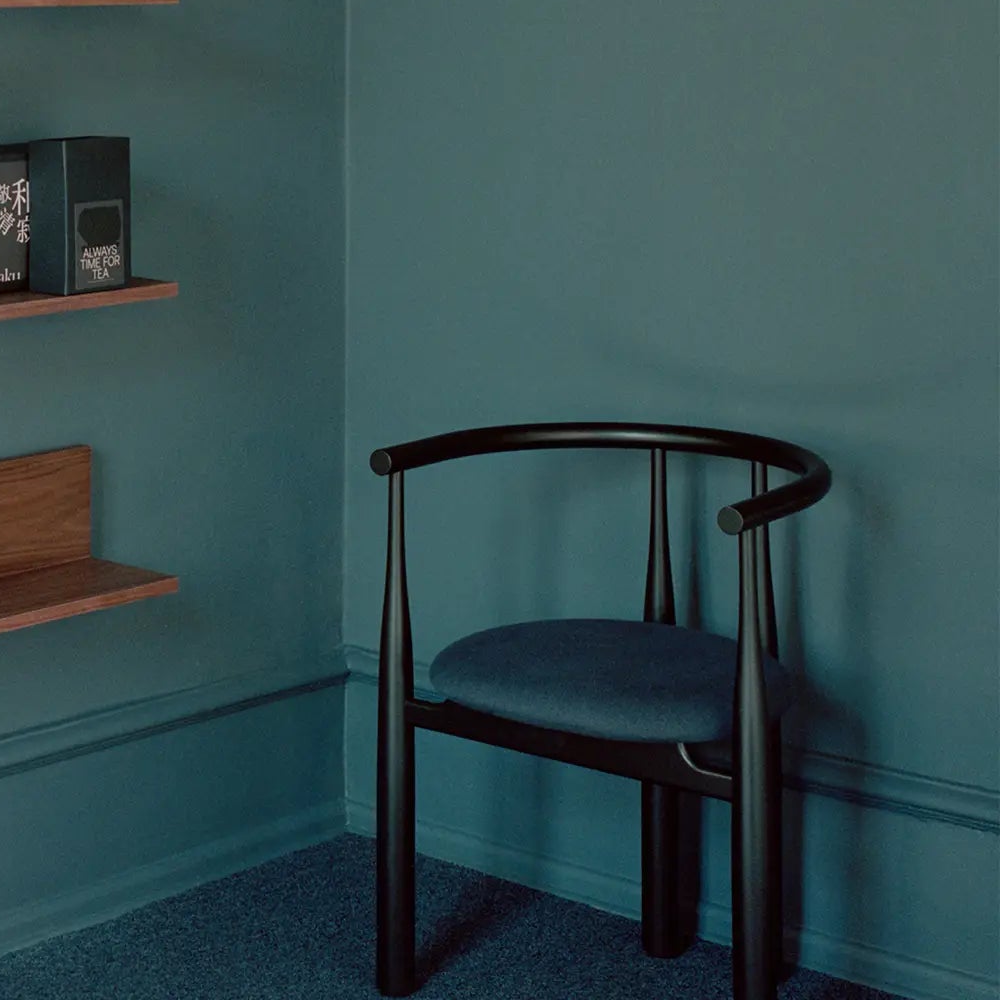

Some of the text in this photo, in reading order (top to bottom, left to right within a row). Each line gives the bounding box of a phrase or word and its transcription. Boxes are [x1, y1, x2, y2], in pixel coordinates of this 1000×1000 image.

[83, 244, 118, 259] ALWAYS
[80, 255, 121, 270] TIME FOR
[92, 268, 110, 280] TEA
